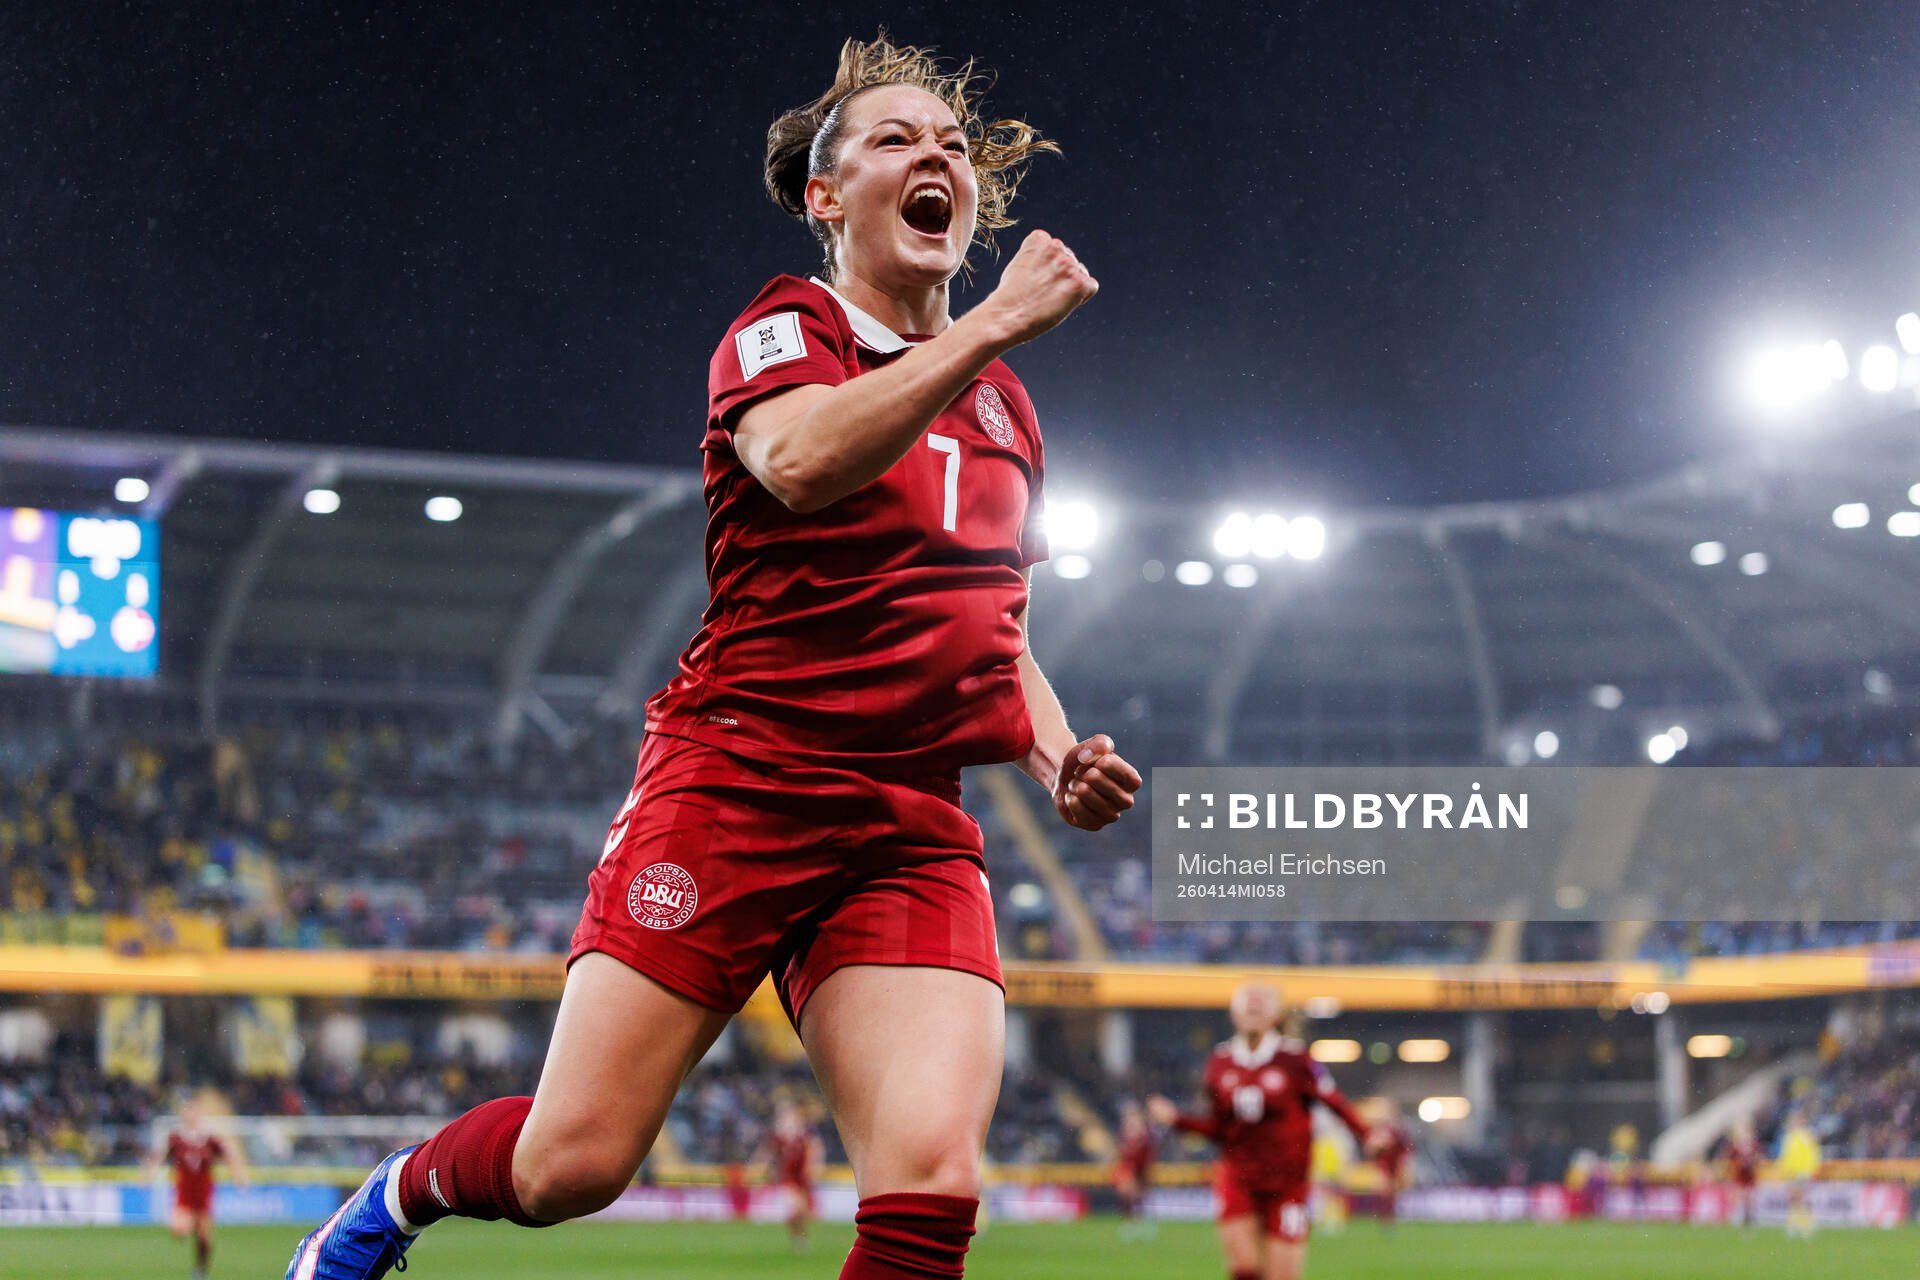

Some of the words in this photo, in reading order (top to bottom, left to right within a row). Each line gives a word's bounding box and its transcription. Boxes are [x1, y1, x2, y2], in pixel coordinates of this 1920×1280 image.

[927, 432, 960, 532] 7
[630, 877, 646, 915] DANSK
[673, 892, 696, 924] UNION
[640, 883, 684, 909] DBU
[640, 915, 669, 928] 1889
